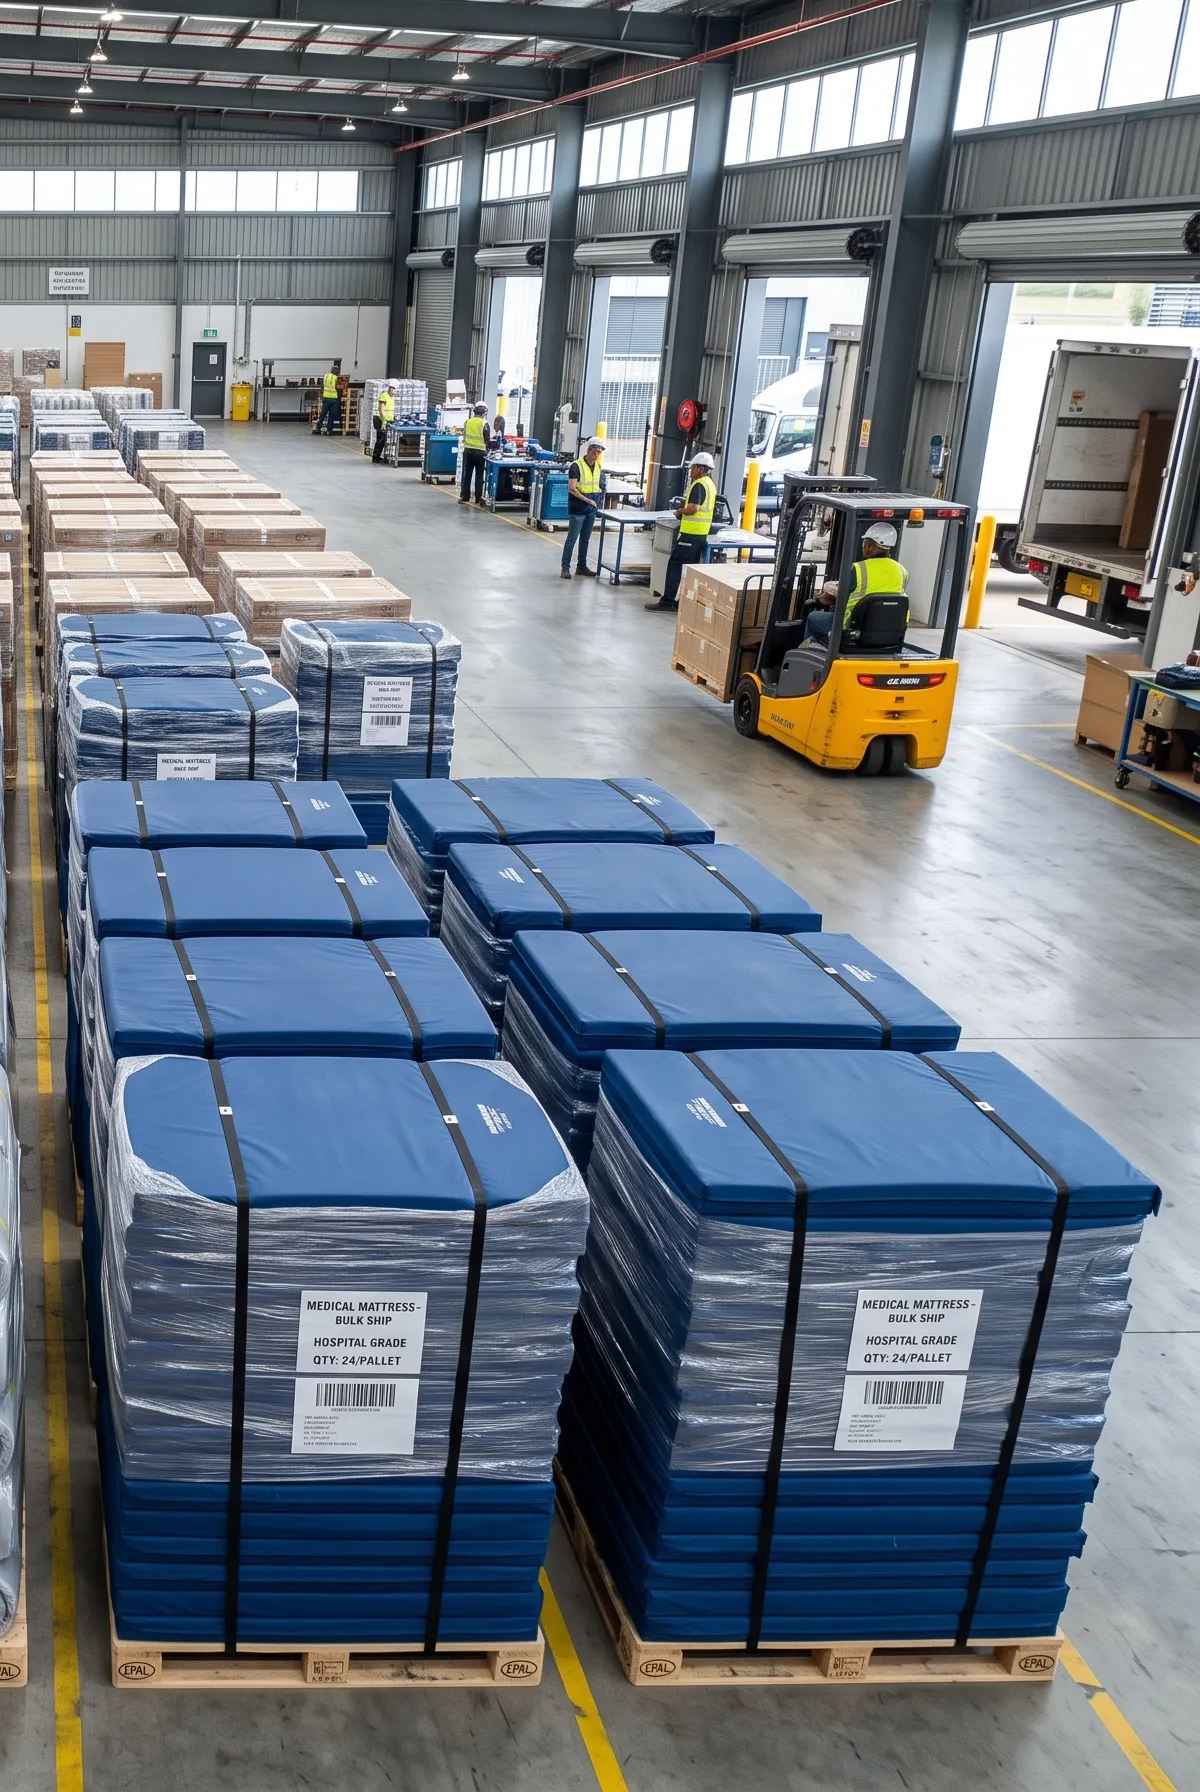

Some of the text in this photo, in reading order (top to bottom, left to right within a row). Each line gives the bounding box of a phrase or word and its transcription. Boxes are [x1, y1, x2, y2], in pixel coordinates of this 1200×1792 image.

[307, 1301, 355, 1312] MEDICAL
[862, 1300, 910, 1309] MEDICAL
[335, 1316, 392, 1325] BULK SHIP
[888, 1314, 945, 1323] BULK SHIP
[313, 1337, 407, 1348] HOSPITAL GRADE
[865, 1335, 958, 1346] HOSPITAL GRADE
[313, 1355, 402, 1367] QTY: 24/PALLET
[863, 1353, 952, 1364] QTY: 24/PALLET
[1023, 1658, 1049, 1668] EPAL
[123, 1665, 149, 1675] EPAL
[506, 1664, 532, 1674] EPAL
